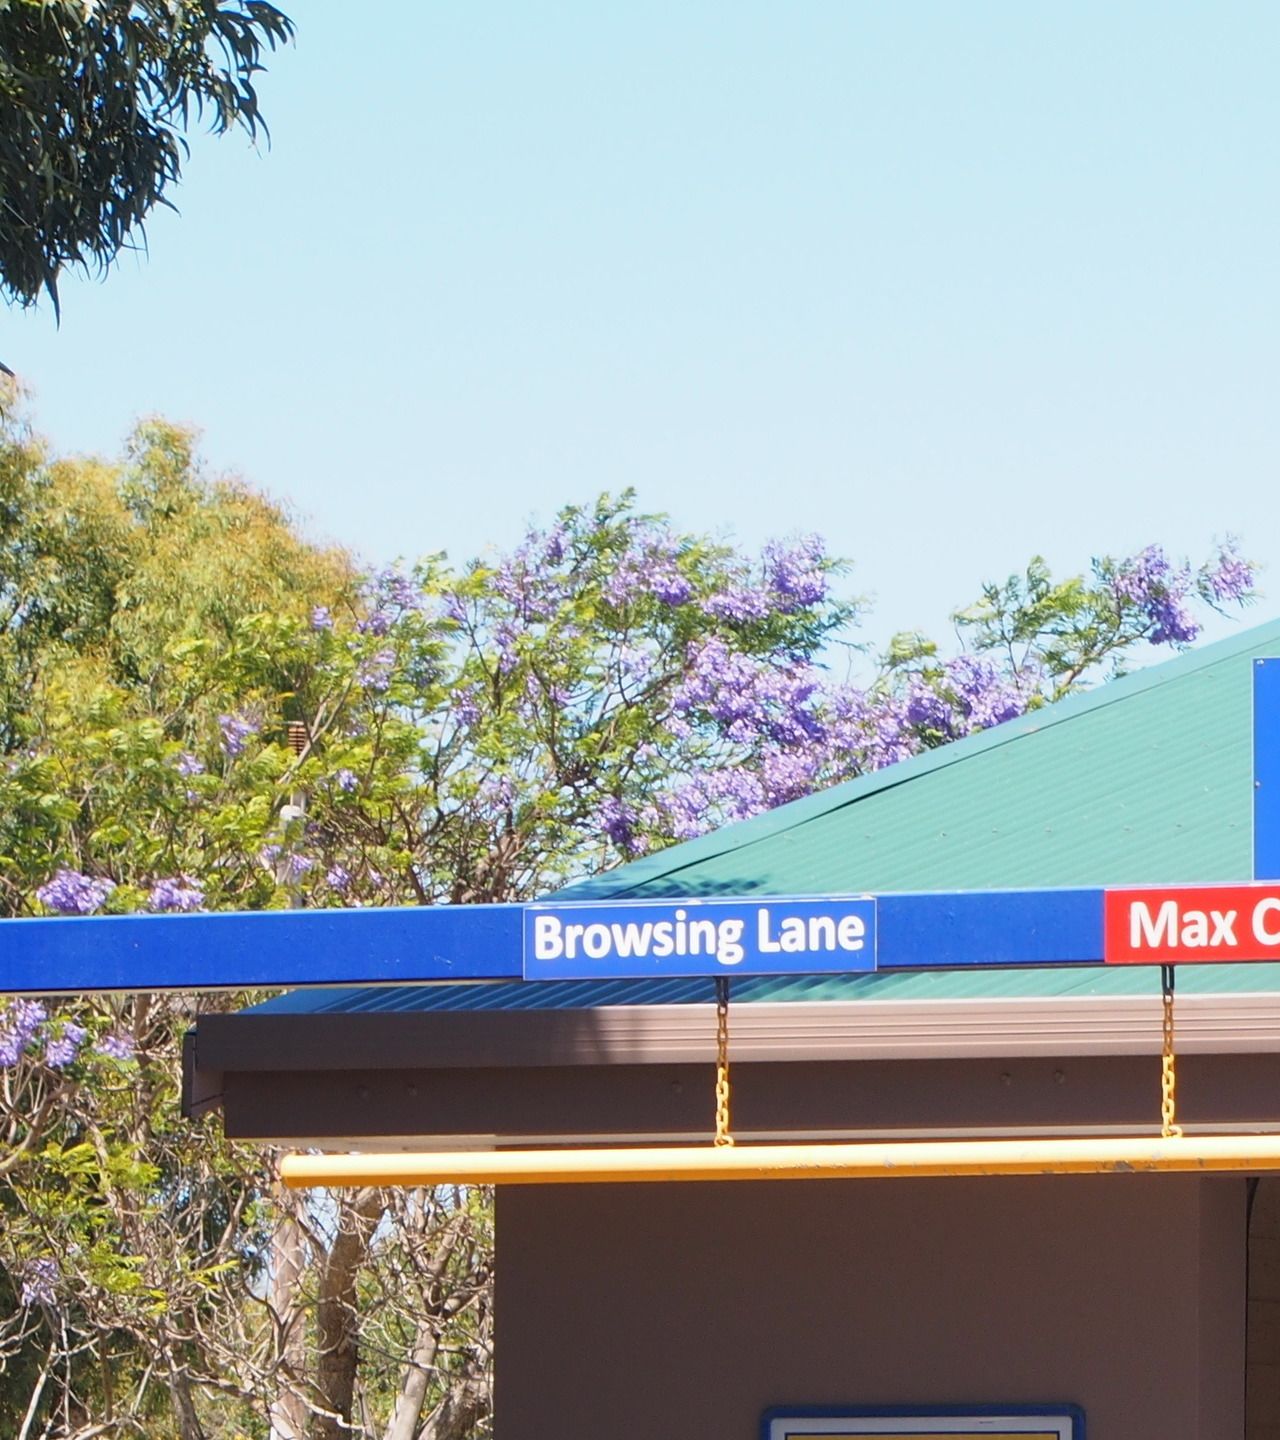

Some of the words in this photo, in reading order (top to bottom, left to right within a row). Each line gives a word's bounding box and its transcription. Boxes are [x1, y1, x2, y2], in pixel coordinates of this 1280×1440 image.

[535, 909, 744, 965] Browsing
[758, 908, 865, 952] Lane
[1129, 900, 1238, 948] Max
